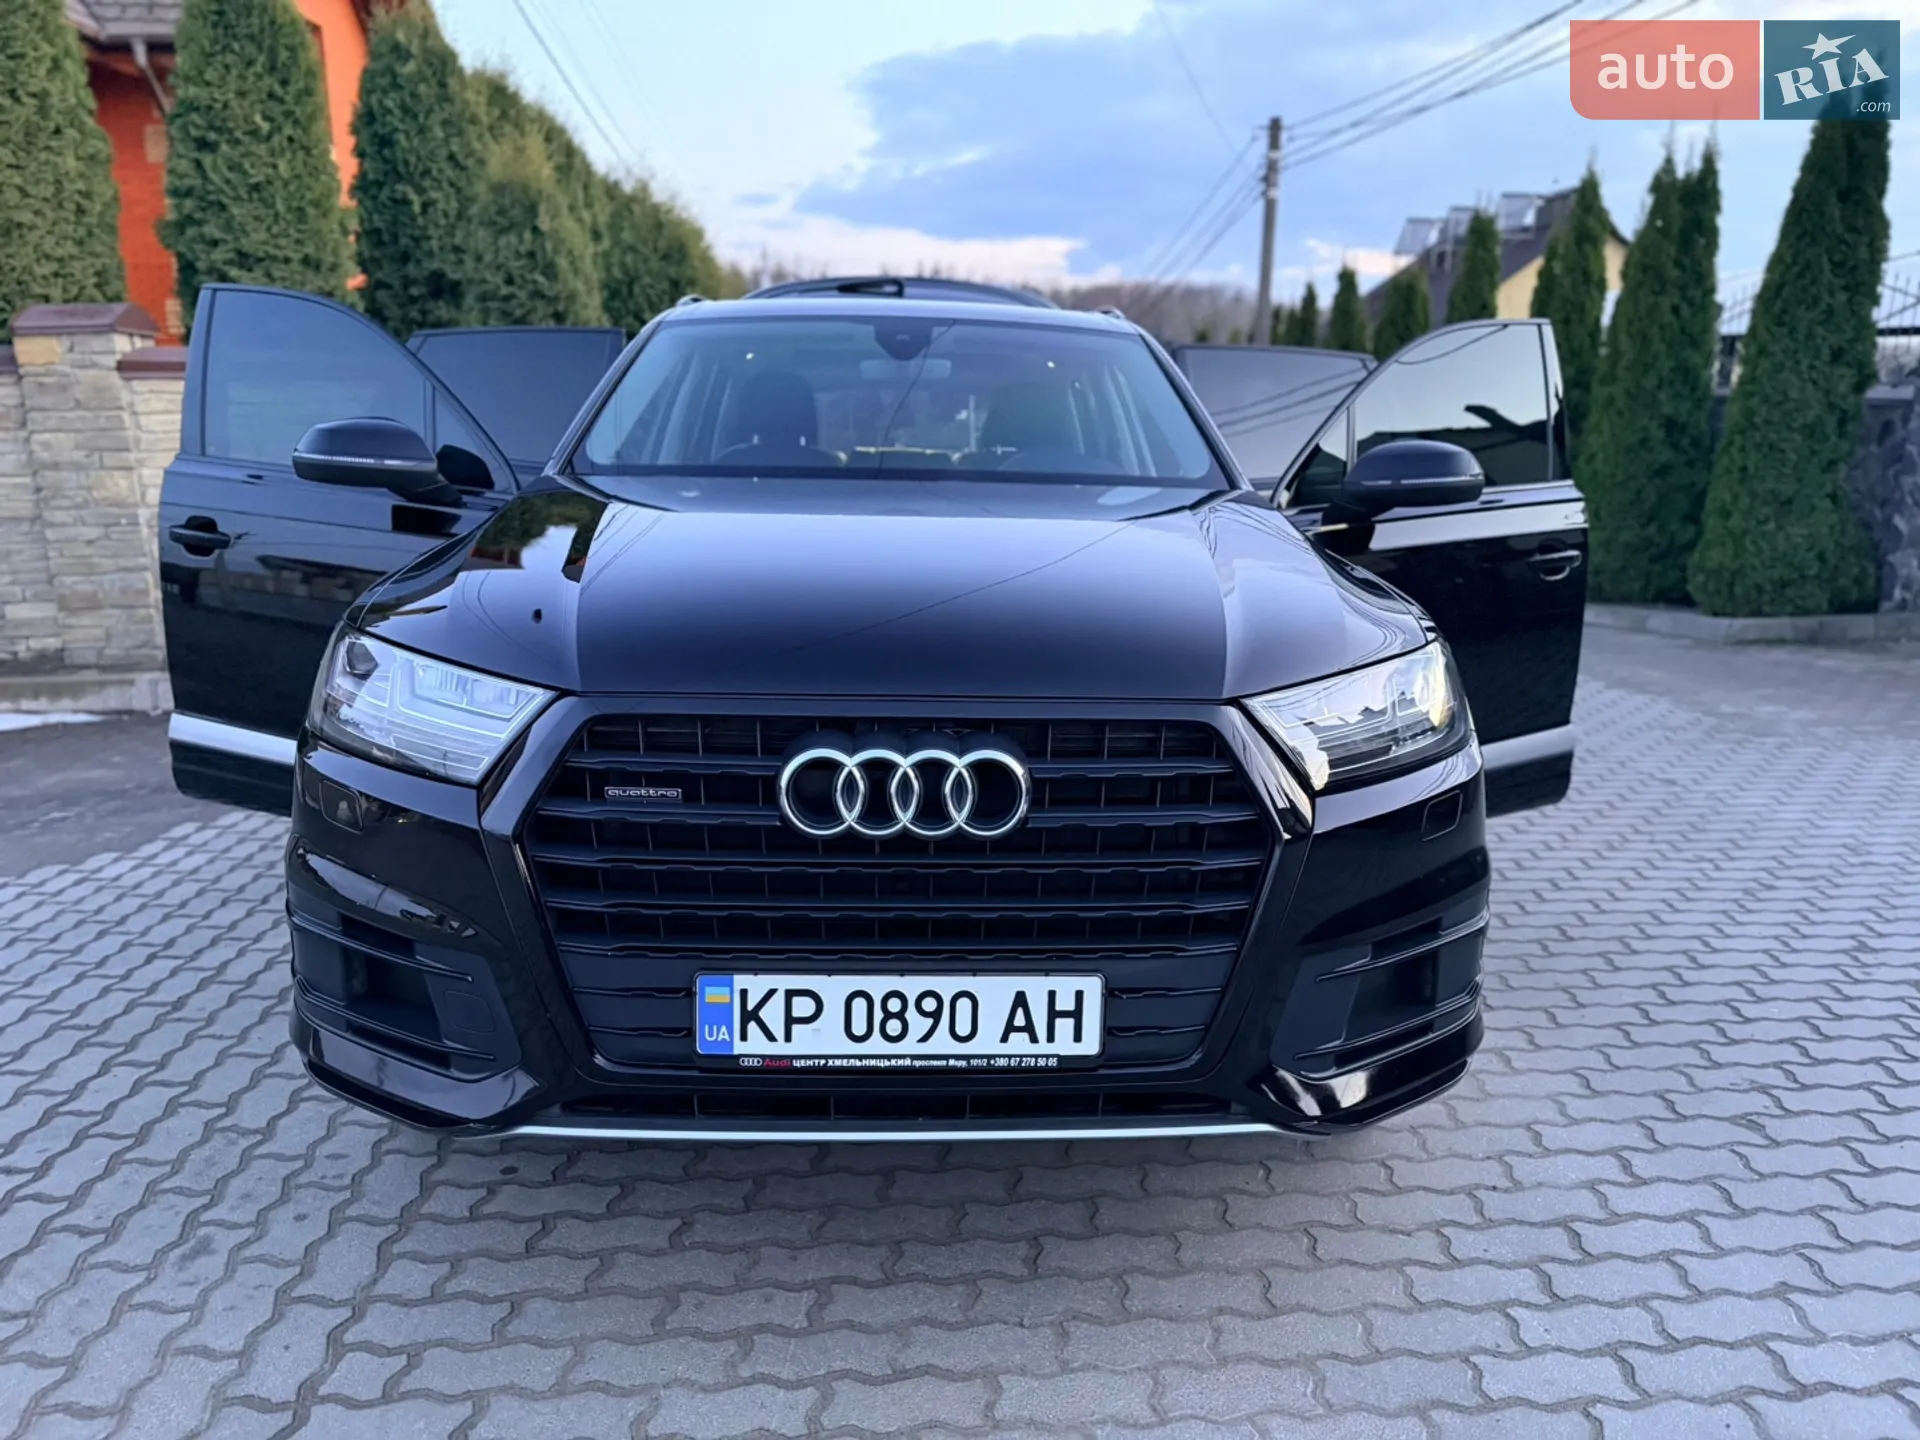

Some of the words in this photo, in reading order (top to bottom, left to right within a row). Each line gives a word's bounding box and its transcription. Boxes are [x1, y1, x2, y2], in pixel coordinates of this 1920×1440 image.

[608, 789, 678, 798] quattro
[739, 988, 824, 1043] KP
[843, 989, 979, 1044] 0890
[999, 990, 1084, 1044] AH
[705, 1024, 731, 1042] UA
[764, 1058, 791, 1067] Audi
[792, 1058, 826, 1068] ЦЕНТР
[826, 1057, 911, 1068] ХМЕЛЬНИЦЬКИЙ
[1010, 1057, 1020, 1067] 67
[1037, 1057, 1047, 1067] 50
